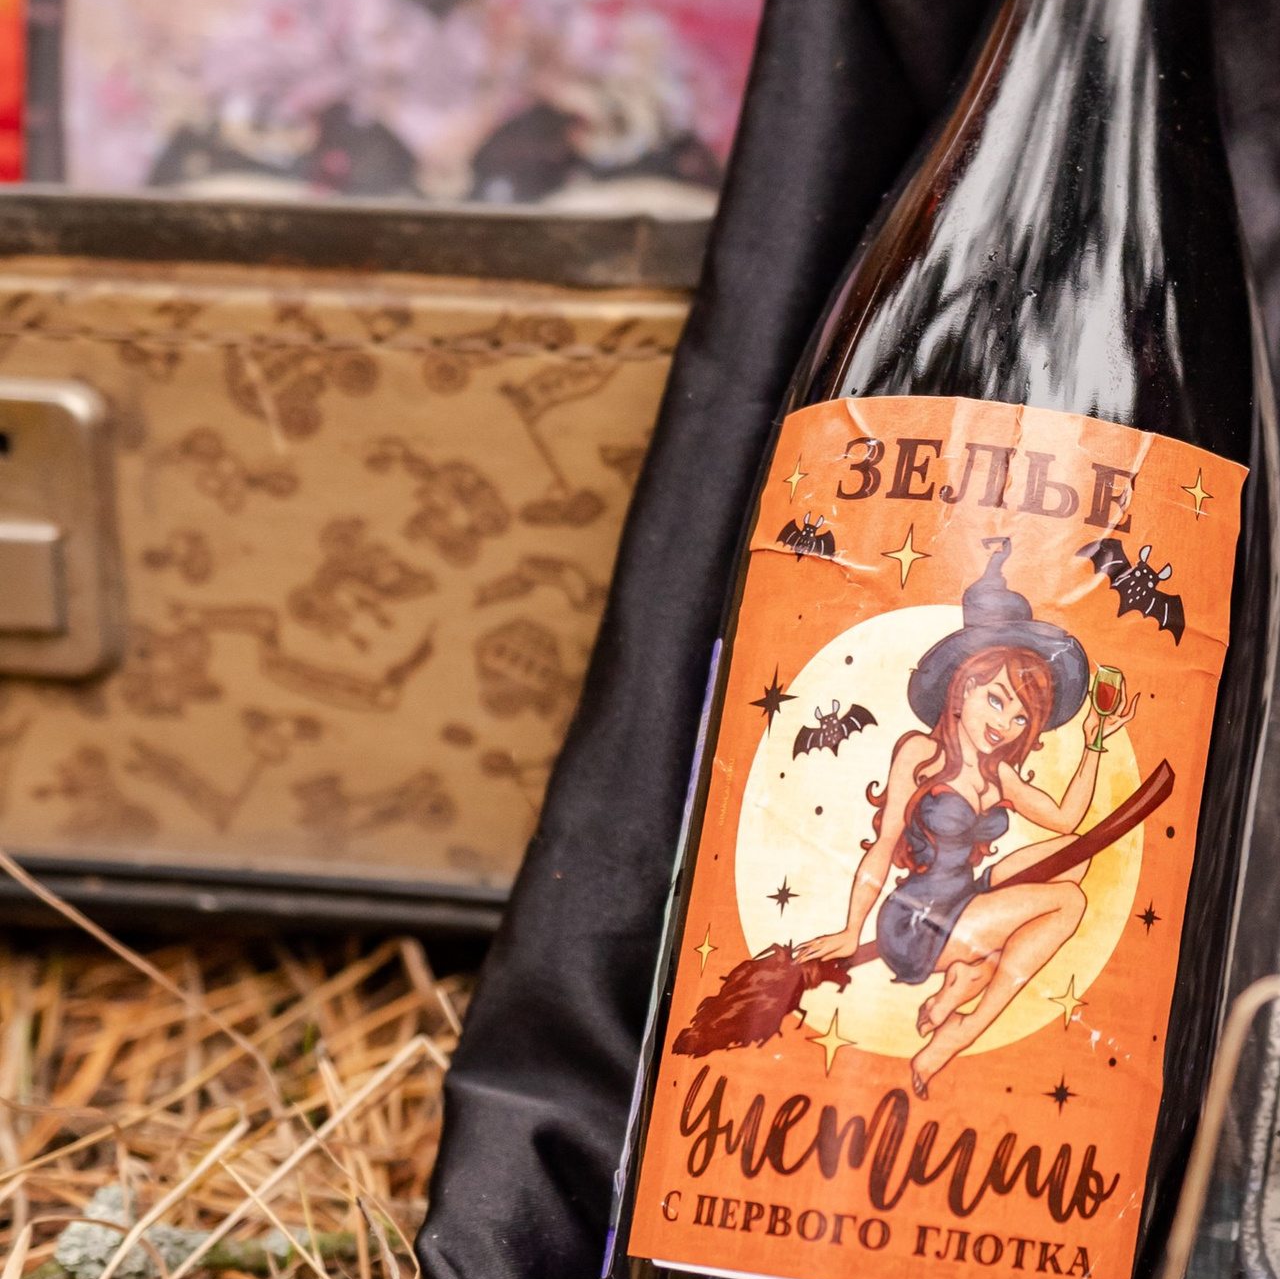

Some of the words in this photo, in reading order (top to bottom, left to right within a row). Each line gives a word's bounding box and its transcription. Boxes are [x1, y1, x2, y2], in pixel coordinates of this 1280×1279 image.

[837, 435, 1139, 535] ЗЕЛЬЕ
[678, 1064, 1122, 1224] Улетишь
[661, 1189, 683, 1223] С
[692, 1193, 892, 1251] ПЕРВОГО
[912, 1224, 1094, 1279] ГЛОТКА
